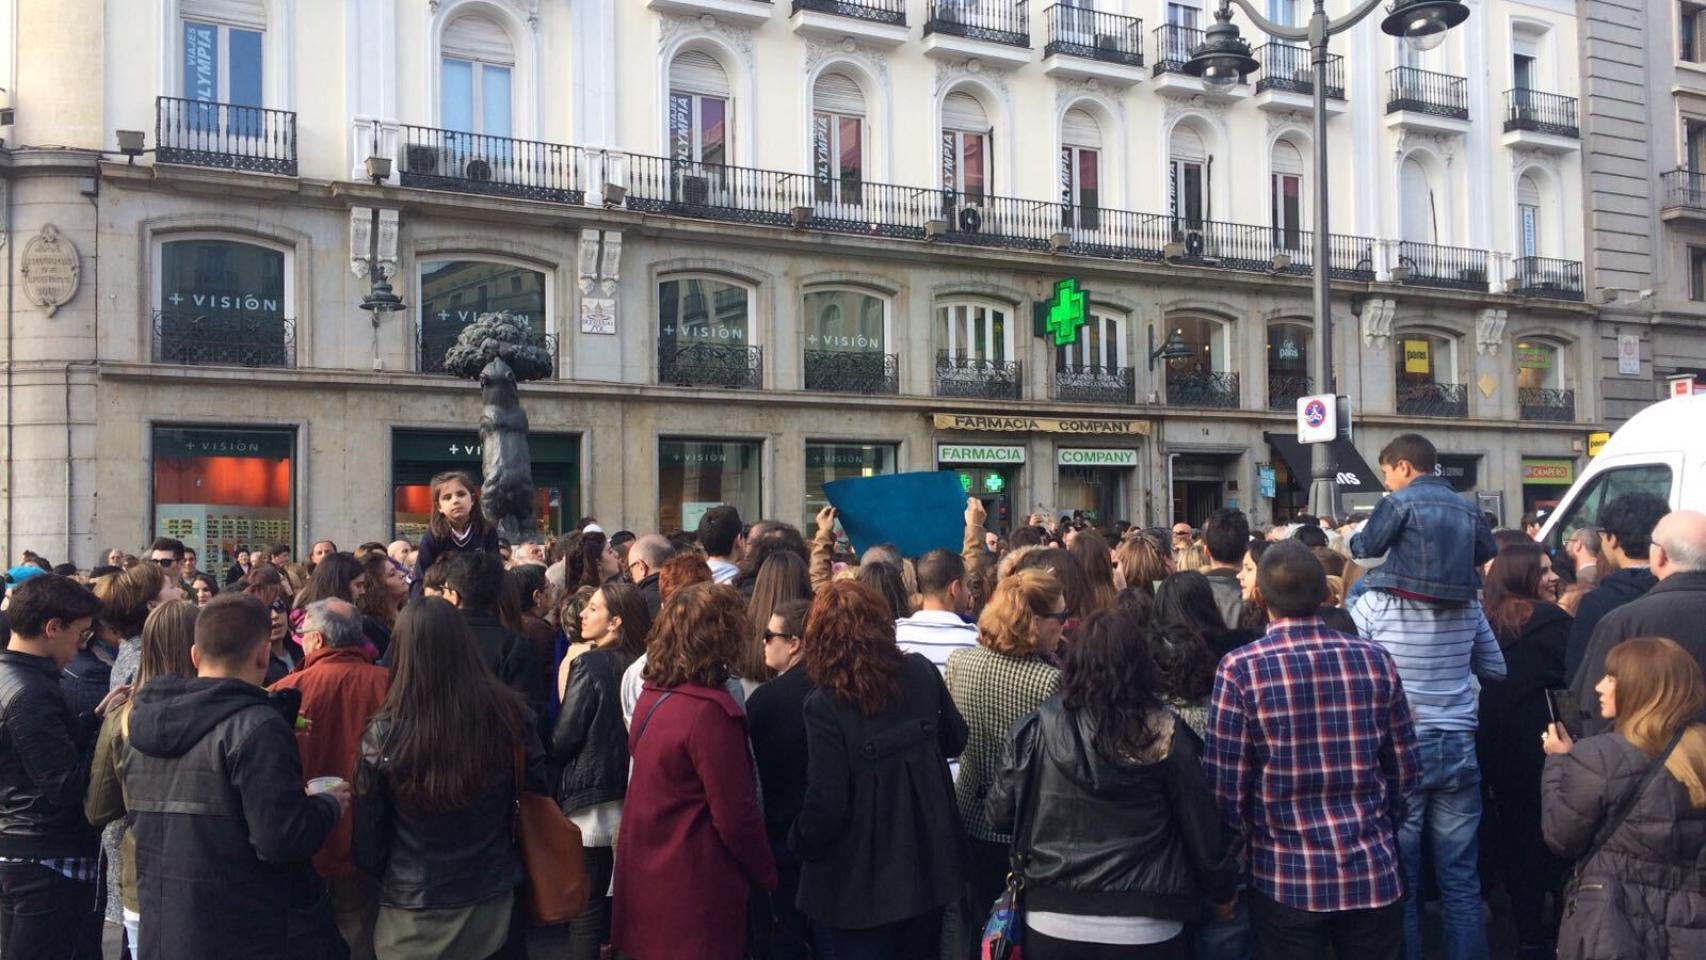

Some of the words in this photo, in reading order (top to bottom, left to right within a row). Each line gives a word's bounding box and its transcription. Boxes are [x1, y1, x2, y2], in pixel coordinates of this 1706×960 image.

[187, 27, 197, 66] VIAJES
[197, 29, 211, 110] OLYMPIA
[678, 97, 689, 168] OLYMPIA
[818, 118, 829, 184] OLYMPIA
[943, 134, 953, 198] OLYMPIA
[193, 293, 277, 312] VISIÓN
[681, 324, 742, 339] VISIÓN
[823, 334, 879, 348] VISIÓN
[954, 416, 1040, 430] FARMACIA
[1059, 420, 1132, 433] COMPANY
[942, 447, 1022, 461] FARMACIA
[1061, 451, 1134, 464] COMPANY
